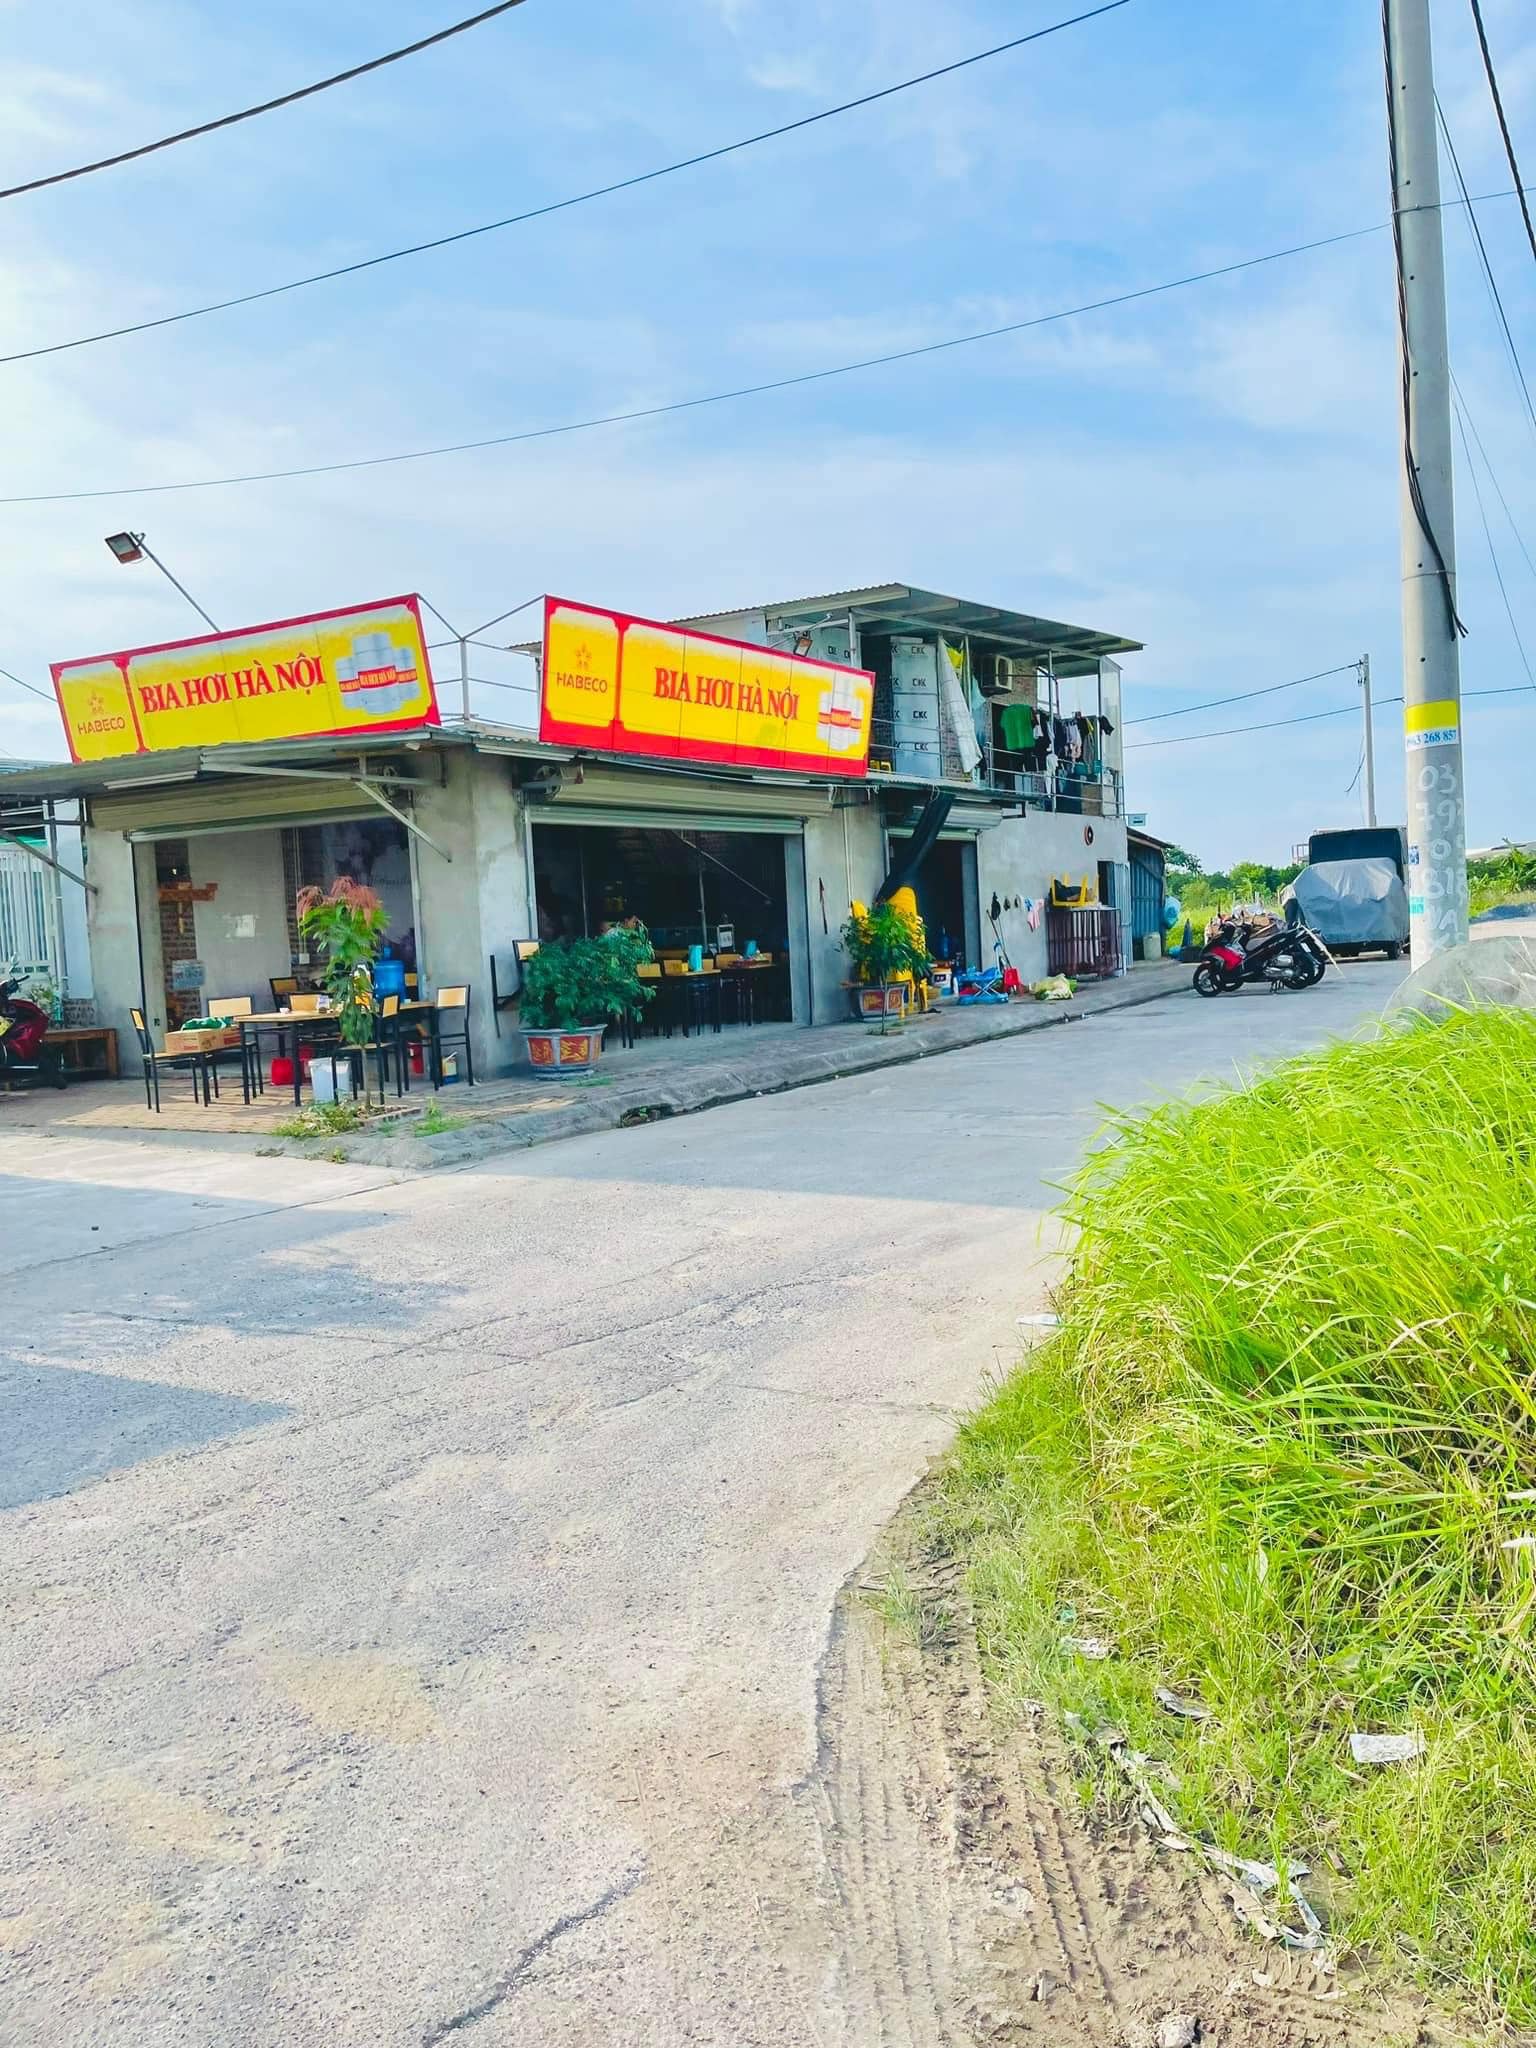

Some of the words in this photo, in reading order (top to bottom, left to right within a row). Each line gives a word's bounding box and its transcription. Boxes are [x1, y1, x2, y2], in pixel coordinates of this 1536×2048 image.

[139, 684, 184, 714] BIA
[234, 660, 275, 698] HÀ
[275, 653, 326, 695] NỘI
[556, 671, 608, 694] HABECO
[653, 667, 692, 703] BIA
[736, 679, 766, 714] HÀ
[766, 686, 801, 726] NỘI
[77, 716, 126, 735] HABECO
[1423, 732, 1441, 743] 268
[1418, 763, 1457, 794] 03
